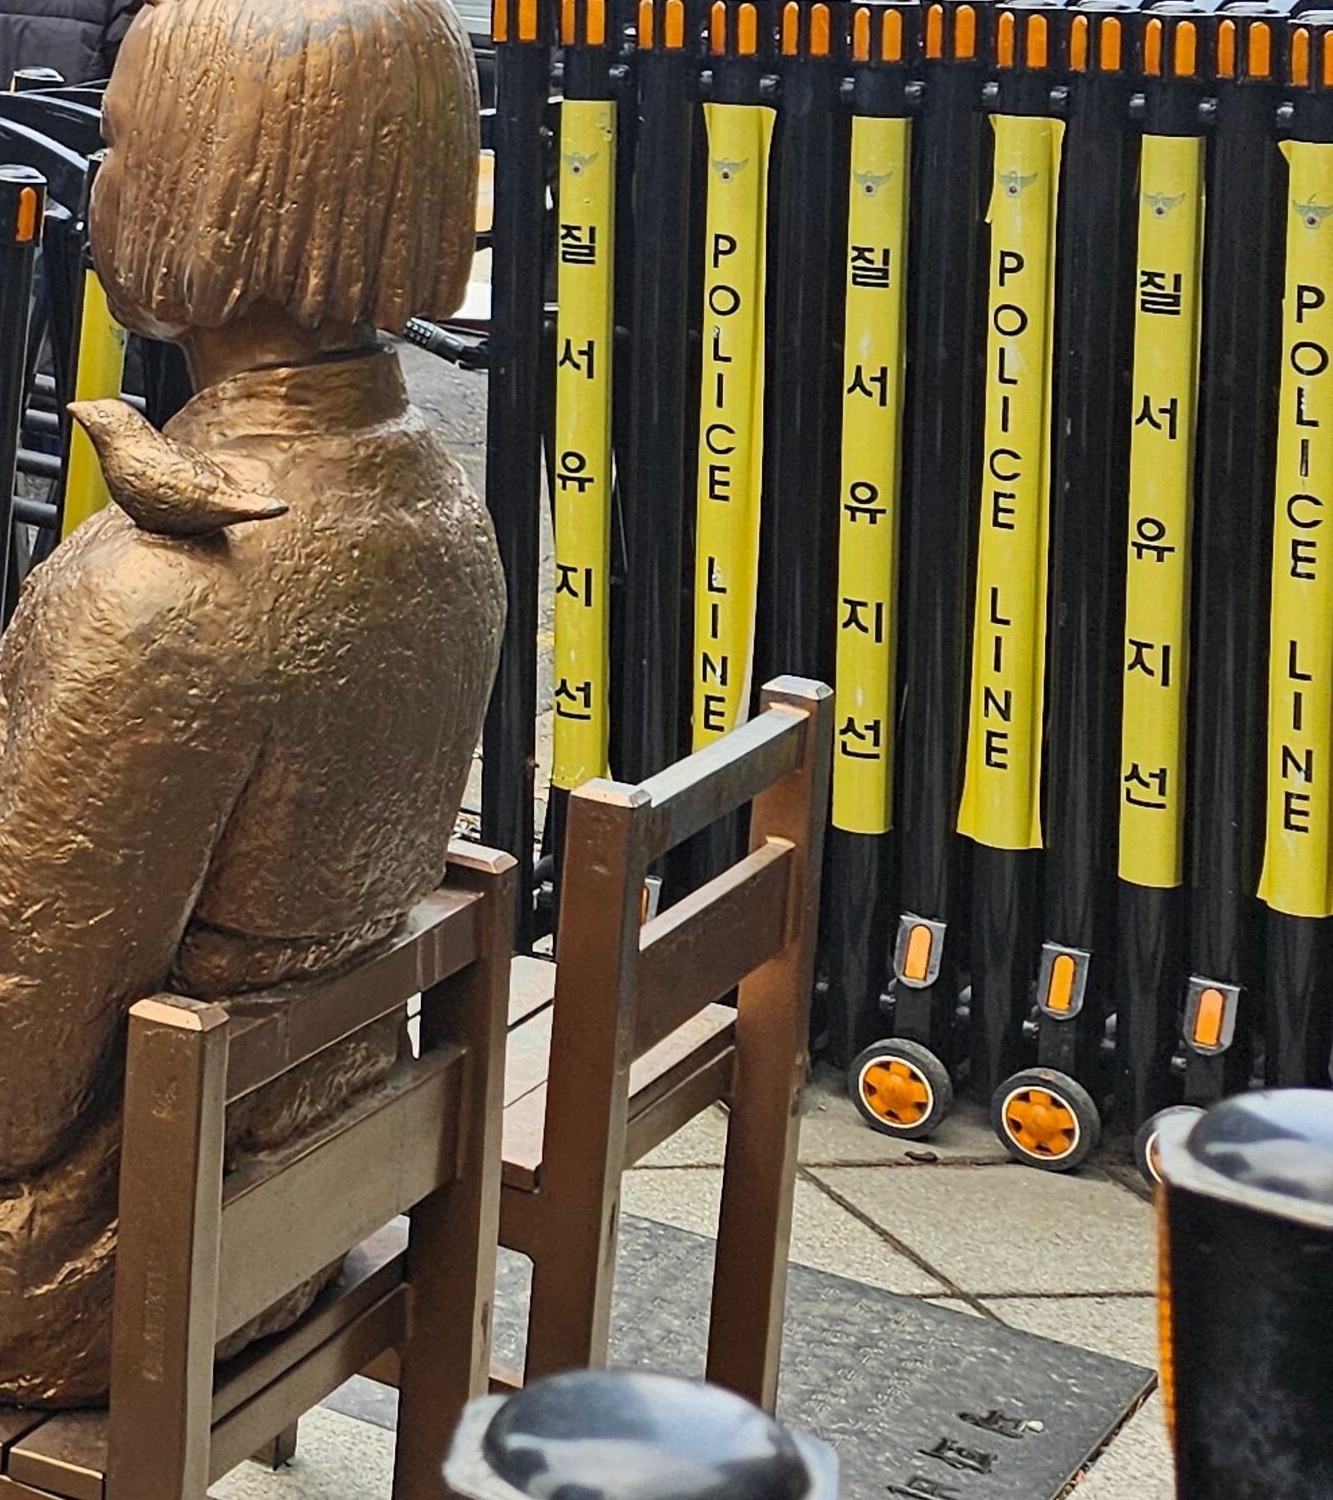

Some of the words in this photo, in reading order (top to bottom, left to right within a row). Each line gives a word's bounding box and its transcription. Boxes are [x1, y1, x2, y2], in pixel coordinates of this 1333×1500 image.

[552, 222, 597, 722] 질서유지선
[704, 232, 742, 503] POLICE
[837, 243, 892, 762] 질서유지선
[988, 249, 1029, 531] POLICE
[1286, 283, 1330, 582] POLICE
[699, 555, 730, 734] LINE
[983, 586, 1013, 771] LINE
[1122, 269, 1183, 811] 질서유지선
[1280, 639, 1314, 834] LINE
